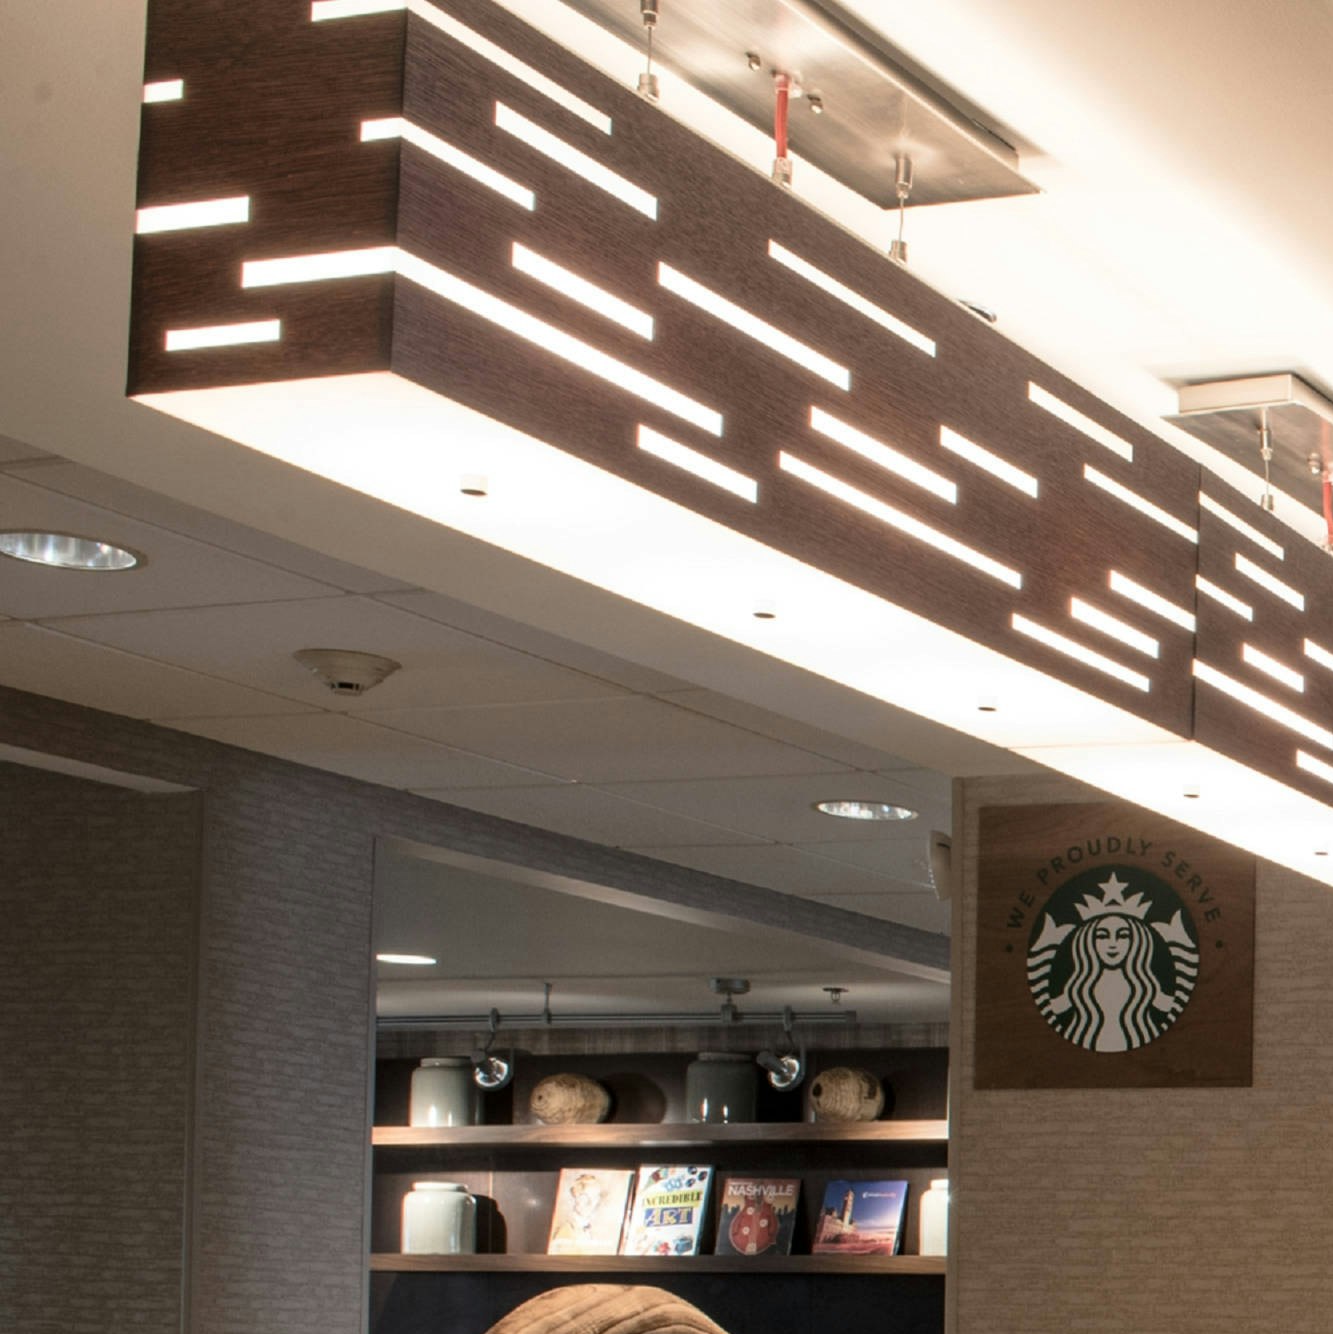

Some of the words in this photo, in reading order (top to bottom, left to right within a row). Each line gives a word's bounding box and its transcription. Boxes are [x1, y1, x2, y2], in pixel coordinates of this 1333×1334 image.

[1006, 891, 1035, 929] WE
[1036, 836, 1152, 886] PROUDLY
[1160, 851, 1222, 923] SERVE
[728, 1183, 795, 1197] NASHVILLE
[645, 1208, 691, 1227] ART
